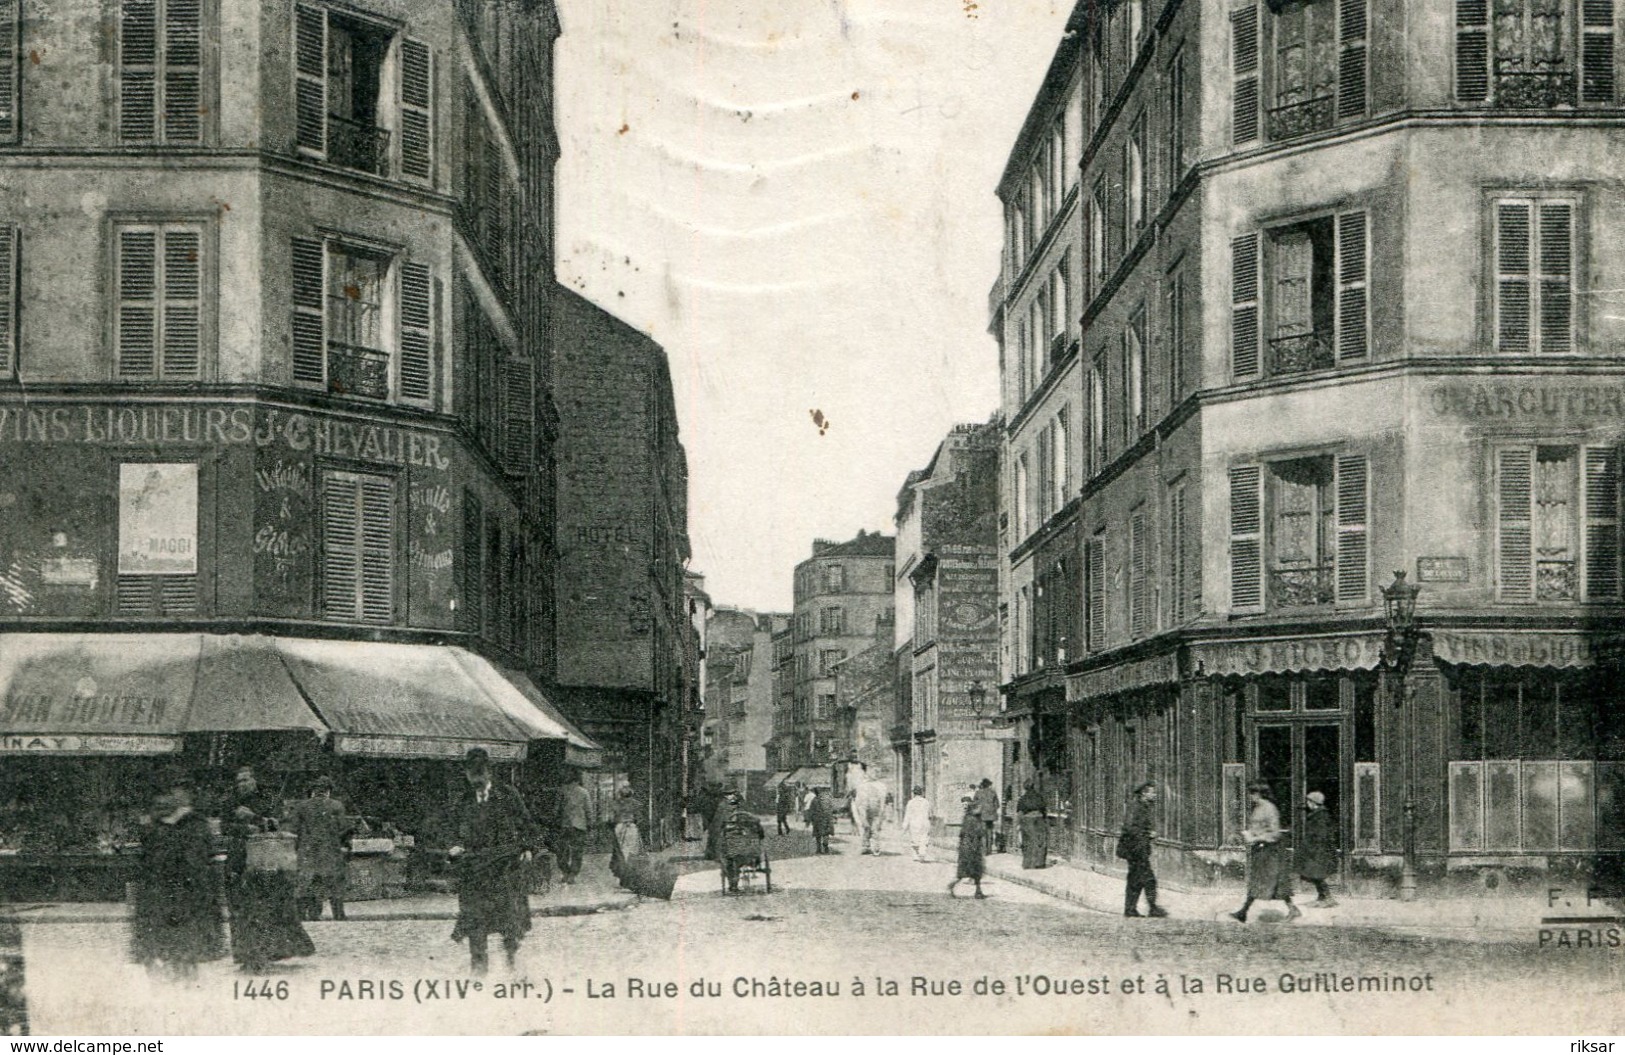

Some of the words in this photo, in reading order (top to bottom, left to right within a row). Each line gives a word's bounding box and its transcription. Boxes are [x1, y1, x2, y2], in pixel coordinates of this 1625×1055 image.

[78, 405, 251, 444] LIQUEURS
[284, 413, 450, 470] CHEVALIER
[149, 538, 192, 553] MAGGI
